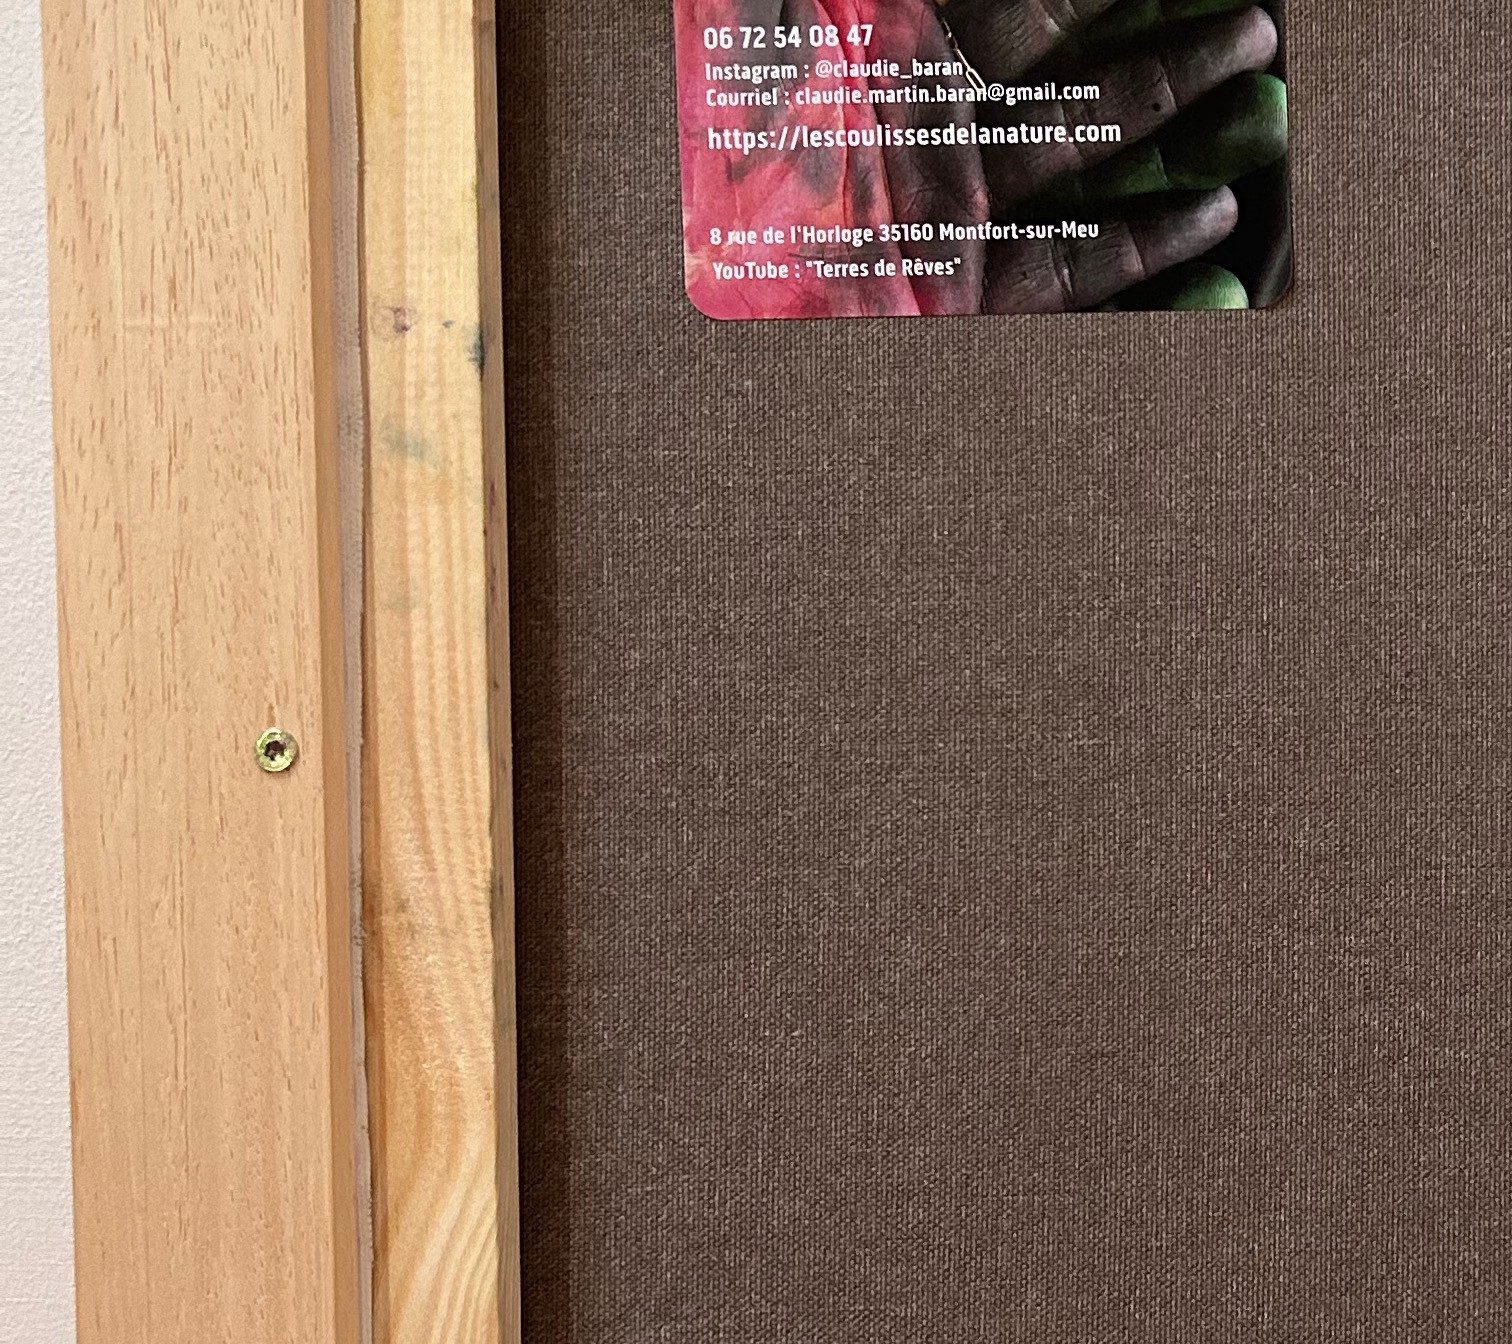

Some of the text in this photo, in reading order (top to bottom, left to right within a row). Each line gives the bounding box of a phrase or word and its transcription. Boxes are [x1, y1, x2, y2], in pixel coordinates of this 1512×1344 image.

[703, 24, 874, 50] 06 72 54 08 47
[705, 62, 798, 85] Instagram
[814, 59, 964, 81] @claudie_baran
[705, 87, 778, 106] Courriel
[795, 83, 1100, 105] claudie.martin.baran@gmail.com
[707, 122, 1122, 155] https://lescoulissesdelanature.com
[709, 220, 1099, 248] 8 rue de l'Horloge 35160 Montfort-sur-Meu
[712, 261, 789, 281] YouTube
[805, 259, 870, 278] "Terres
[874, 258, 897, 277] de
[901, 257, 962, 277] Rêves"
